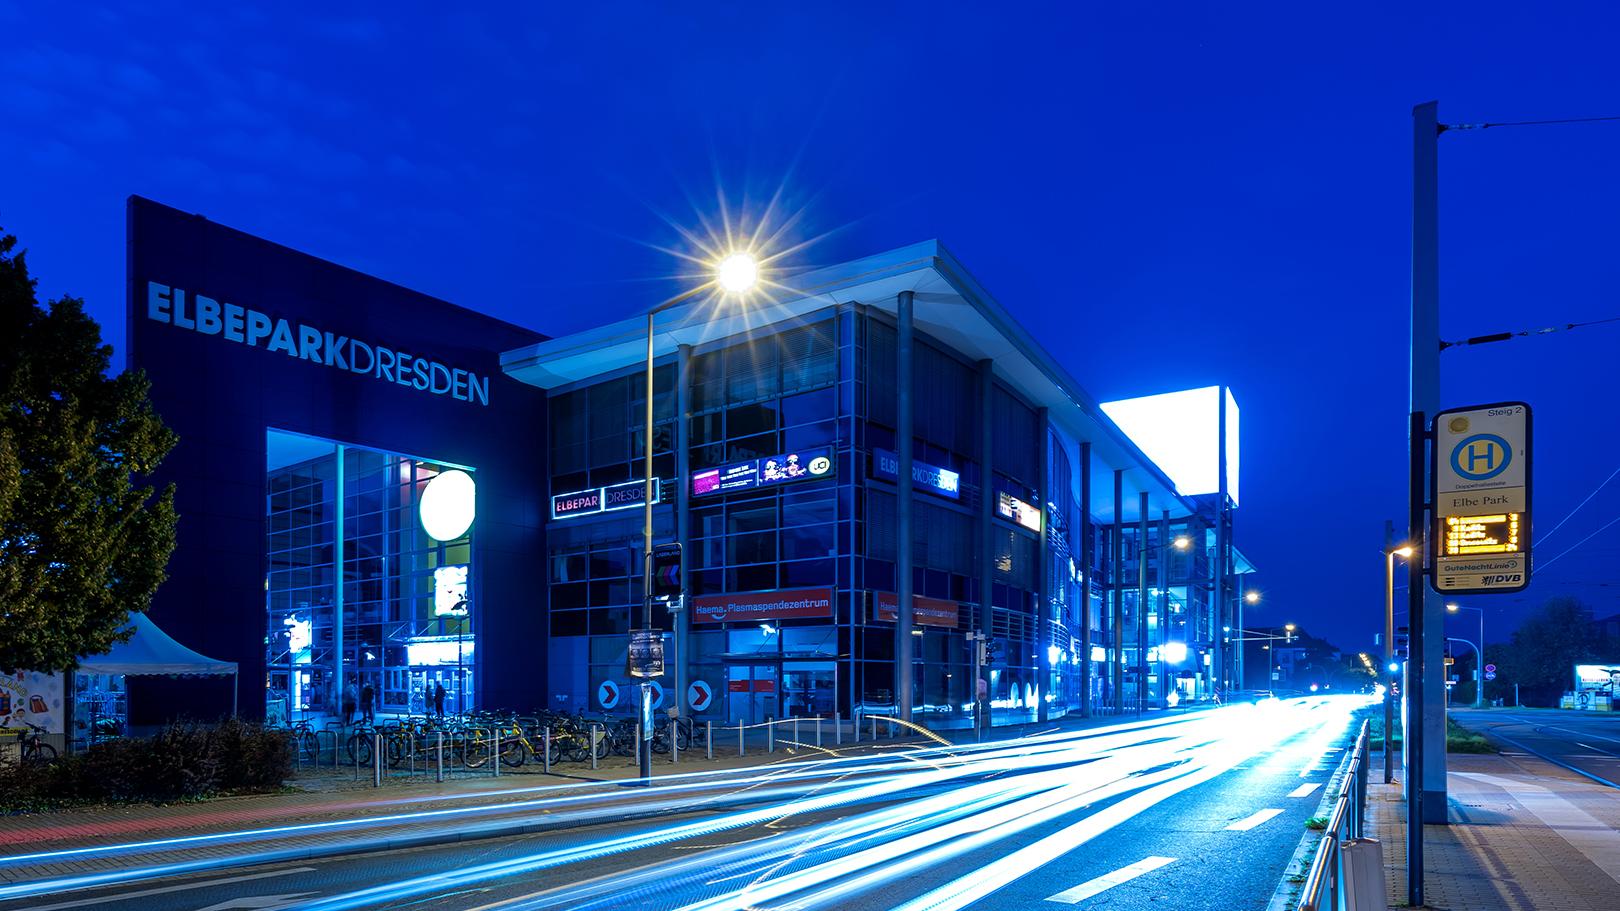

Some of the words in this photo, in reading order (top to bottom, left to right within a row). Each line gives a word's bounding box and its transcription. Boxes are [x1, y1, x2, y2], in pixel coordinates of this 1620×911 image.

[147, 281, 490, 406] ELBEPARKDRESDEN
[1488, 409, 1513, 417] Steig
[1453, 497, 1479, 508] Elbe
[1483, 495, 1509, 505] Park
[1444, 563, 1510, 572] GuteNachtLinie
[1495, 574, 1521, 582] DVB
[728, 599, 829, 613] Plasmaspendezentrum
